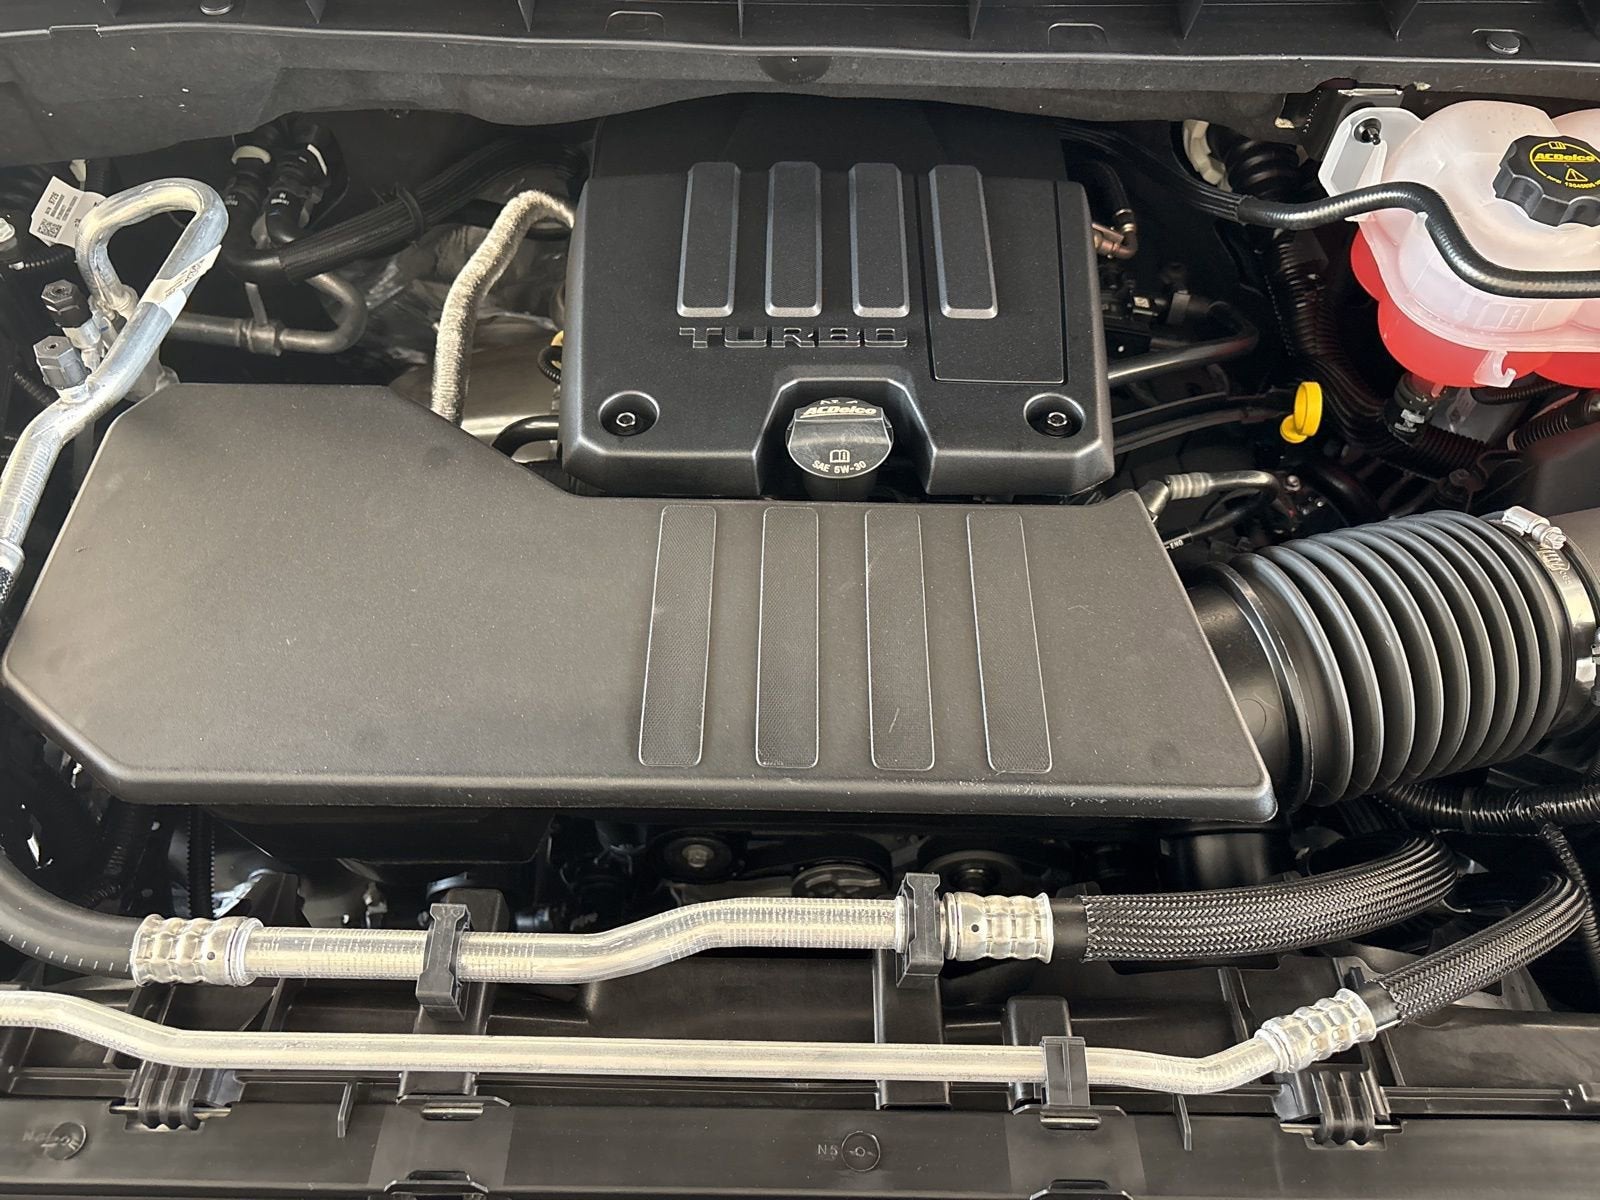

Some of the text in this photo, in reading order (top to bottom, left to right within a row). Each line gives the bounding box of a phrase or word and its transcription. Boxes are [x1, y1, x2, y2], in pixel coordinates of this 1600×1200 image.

[1533, 152, 1596, 162] ACDelco
[679, 327, 908, 349] TURBO
[801, 405, 877, 417] ACDelco
[811, 460, 831, 473] SAE
